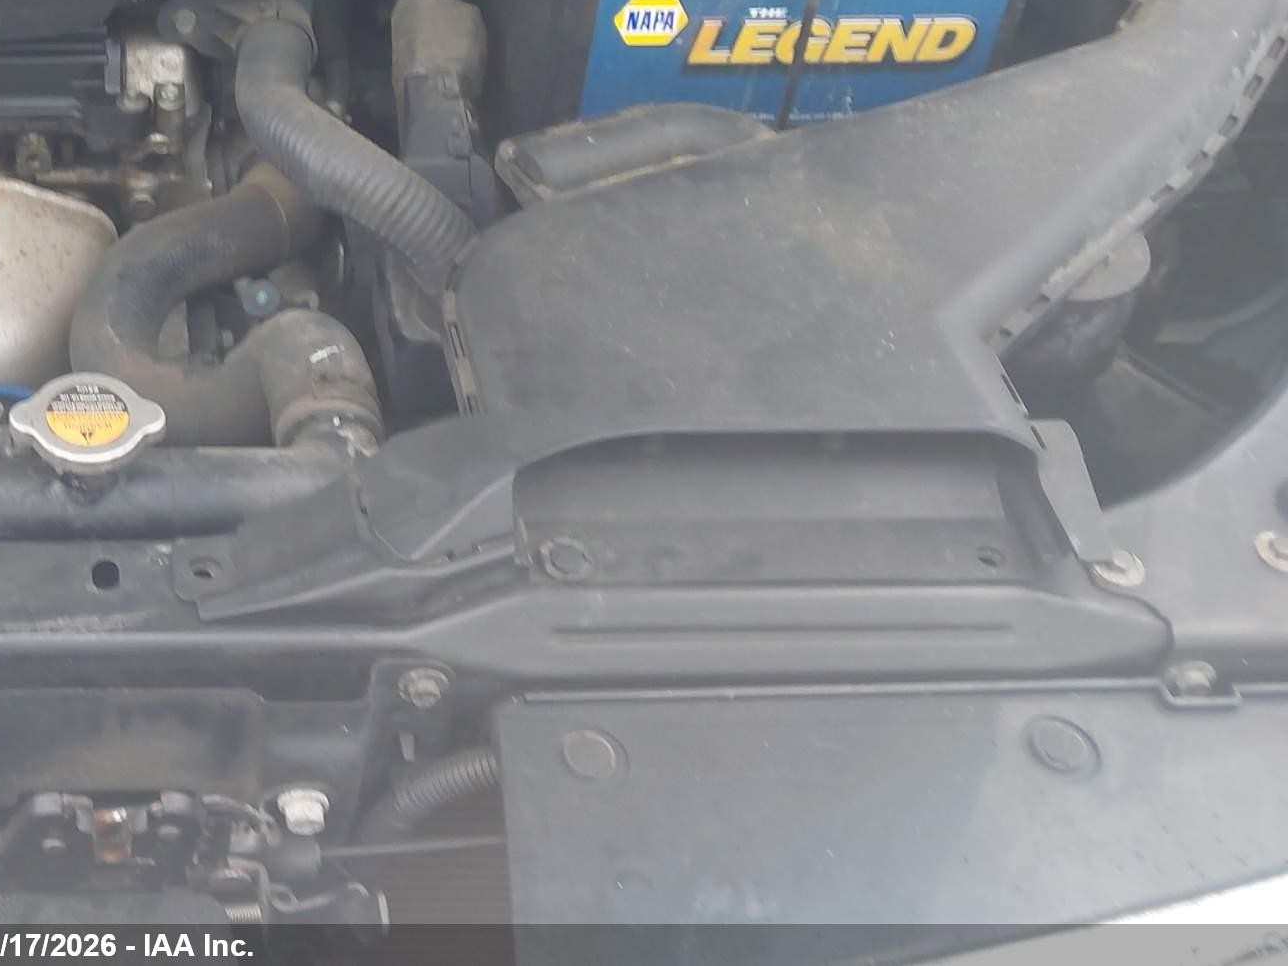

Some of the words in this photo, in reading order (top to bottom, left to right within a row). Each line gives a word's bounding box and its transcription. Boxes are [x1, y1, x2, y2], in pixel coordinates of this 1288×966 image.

[626, 9, 676, 31] NAPA
[748, 7, 788, 19] THE
[687, 17, 977, 64] LEGEND
